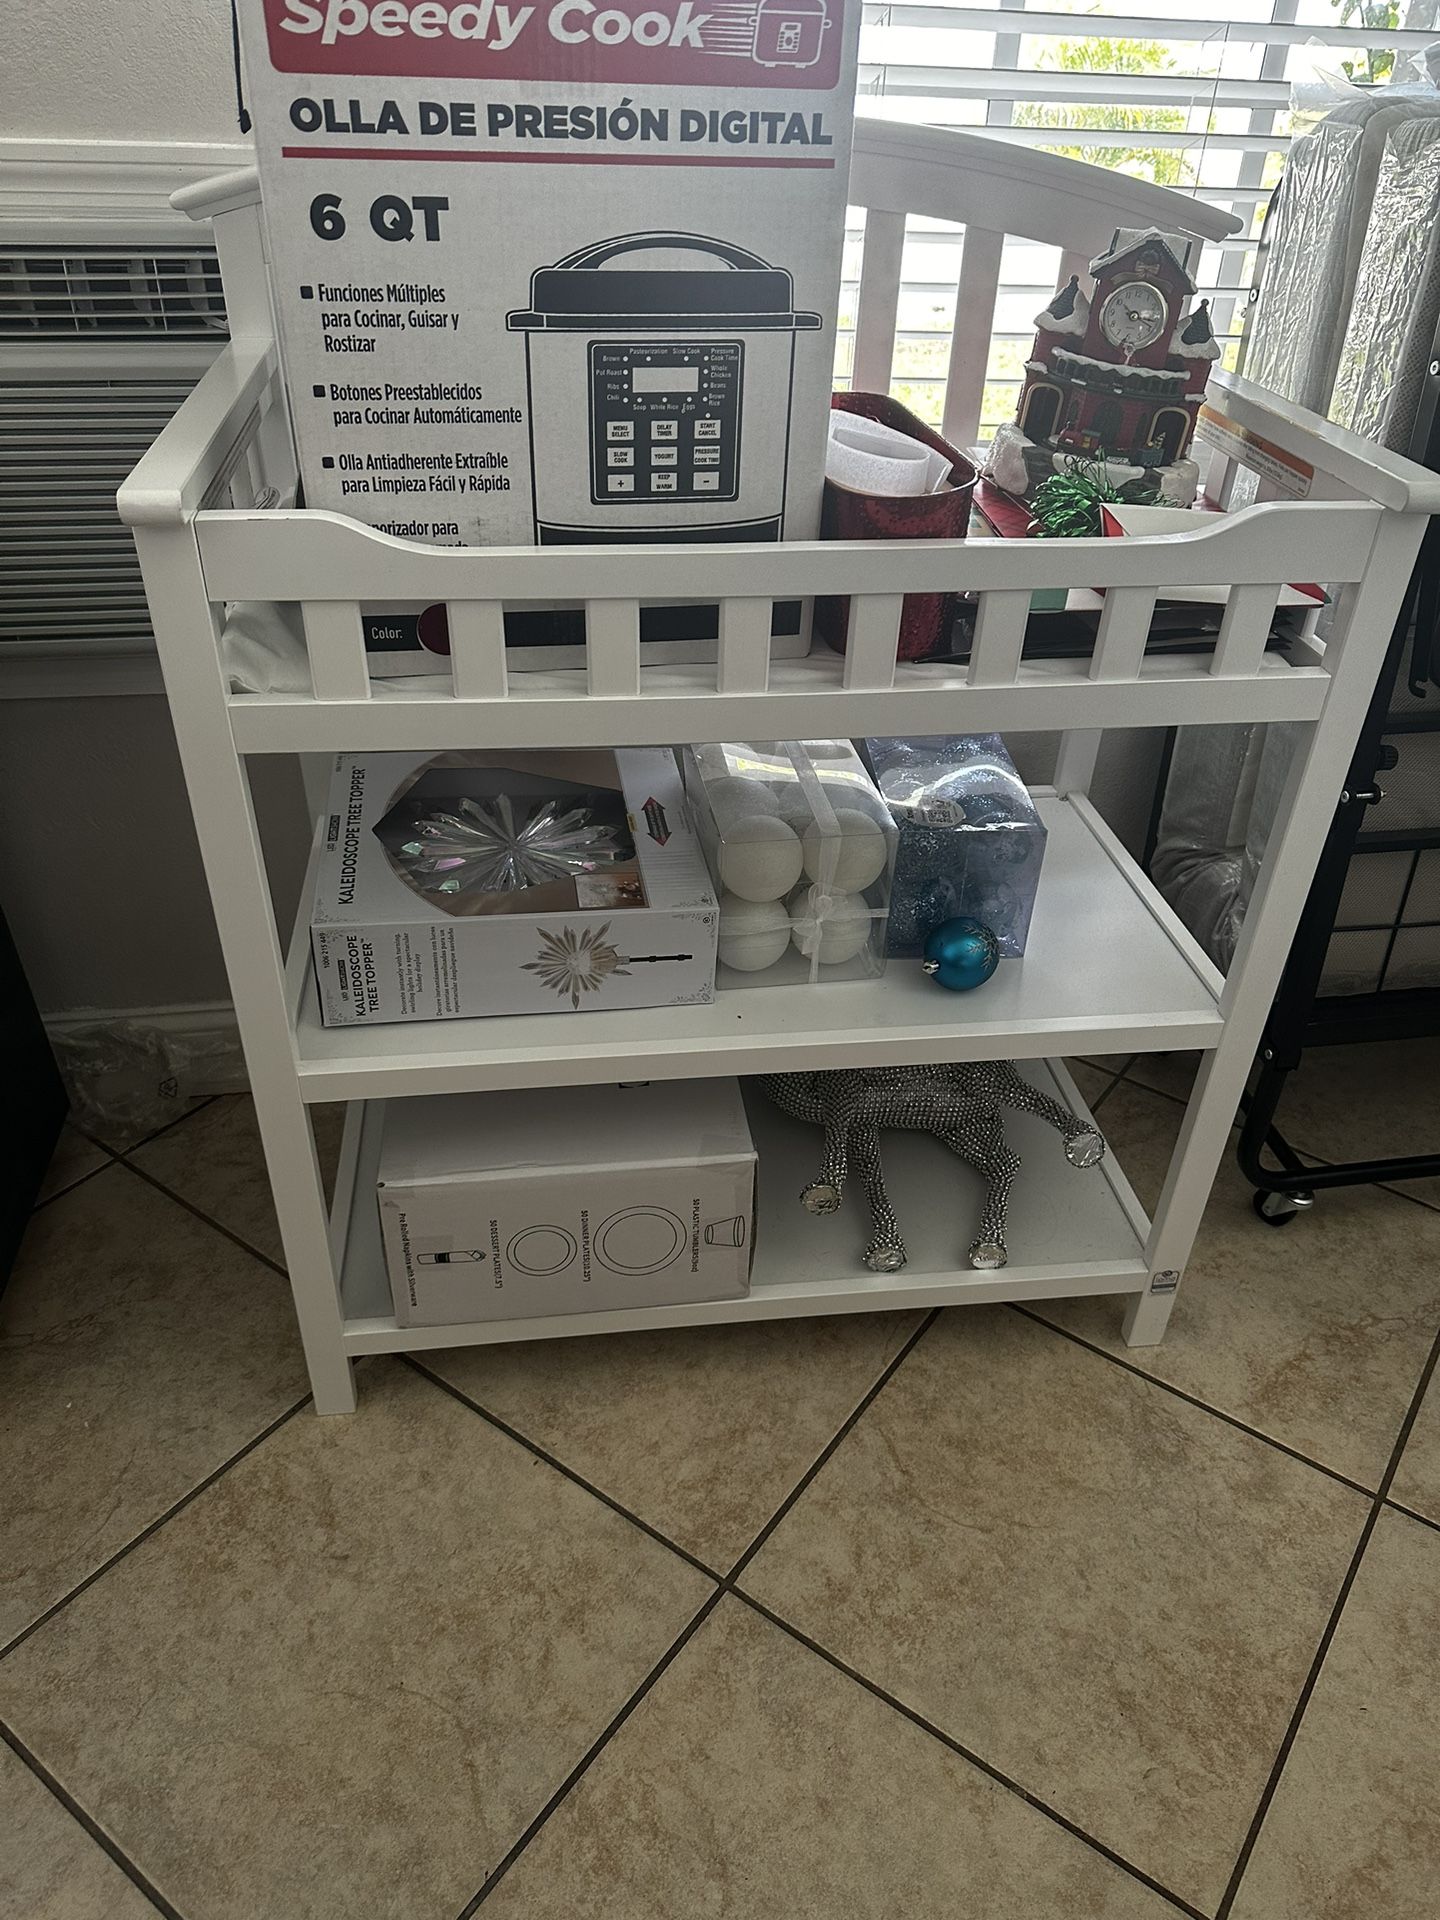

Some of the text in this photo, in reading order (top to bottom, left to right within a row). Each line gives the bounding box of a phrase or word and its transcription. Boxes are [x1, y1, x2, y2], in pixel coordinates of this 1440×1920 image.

[279, 0, 713, 50] Speedy Cook
[289, 98, 833, 145] OLLA DE PRESIÓN DIGITAL
[310, 193, 449, 243] 6 QT
[318, 283, 446, 305] Funciones Múltiples
[321, 310, 459, 330] para Cocinar, Guisar y
[324, 335, 376, 352] Rostizar
[330, 383, 482, 401] Botones Preestablecidos
[333, 406, 522, 427] para Cocinar Automáticamente
[339, 452, 508, 470] Olla Antiadherente Extraíble
[342, 474, 510, 495] para Limpieza Fácil y Rápida
[432, 522, 459, 537] para
[346, 804, 363, 827] TREE
[338, 828, 360, 905] KALEIDOSCOPE
[346, 935, 366, 1016] KALEIDOSCOPE
[366, 986, 379, 1012] TREE
[399, 1213, 407, 1223] Pre
[581, 1217, 590, 1240] DINNER
[692, 1206, 700, 1230] PLASTIC
[490, 1227, 500, 1253] DESSERT
[403, 1242, 412, 1265] Napkins
[406, 1265, 414, 1278] with
[408, 1278, 418, 1307] Silverware
